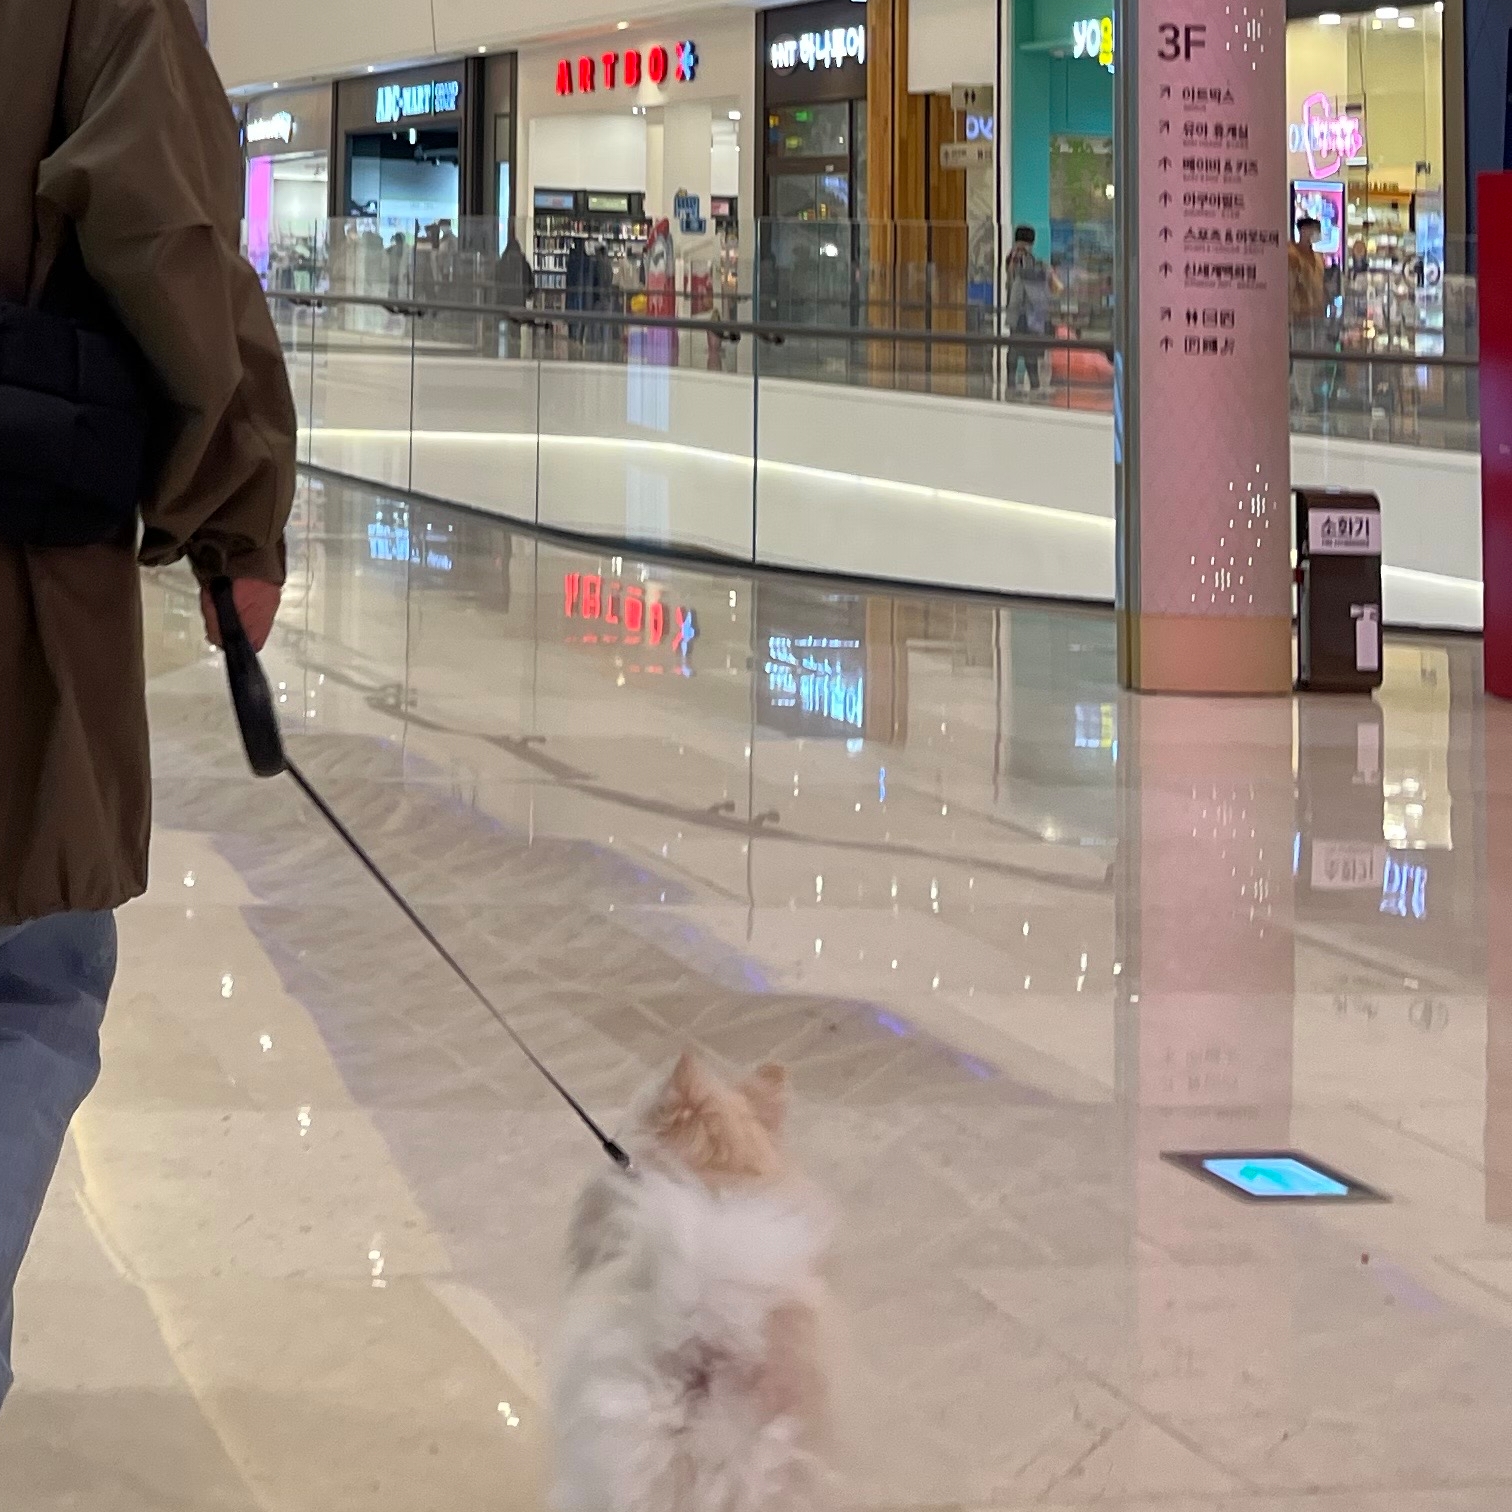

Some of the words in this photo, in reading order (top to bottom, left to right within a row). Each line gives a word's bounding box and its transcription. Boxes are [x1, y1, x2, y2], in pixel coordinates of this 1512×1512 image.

[1157, 23, 1207, 61] 3F
[556, 40, 698, 96] ARTBOX
[1320, 515, 1370, 539] 소화기
